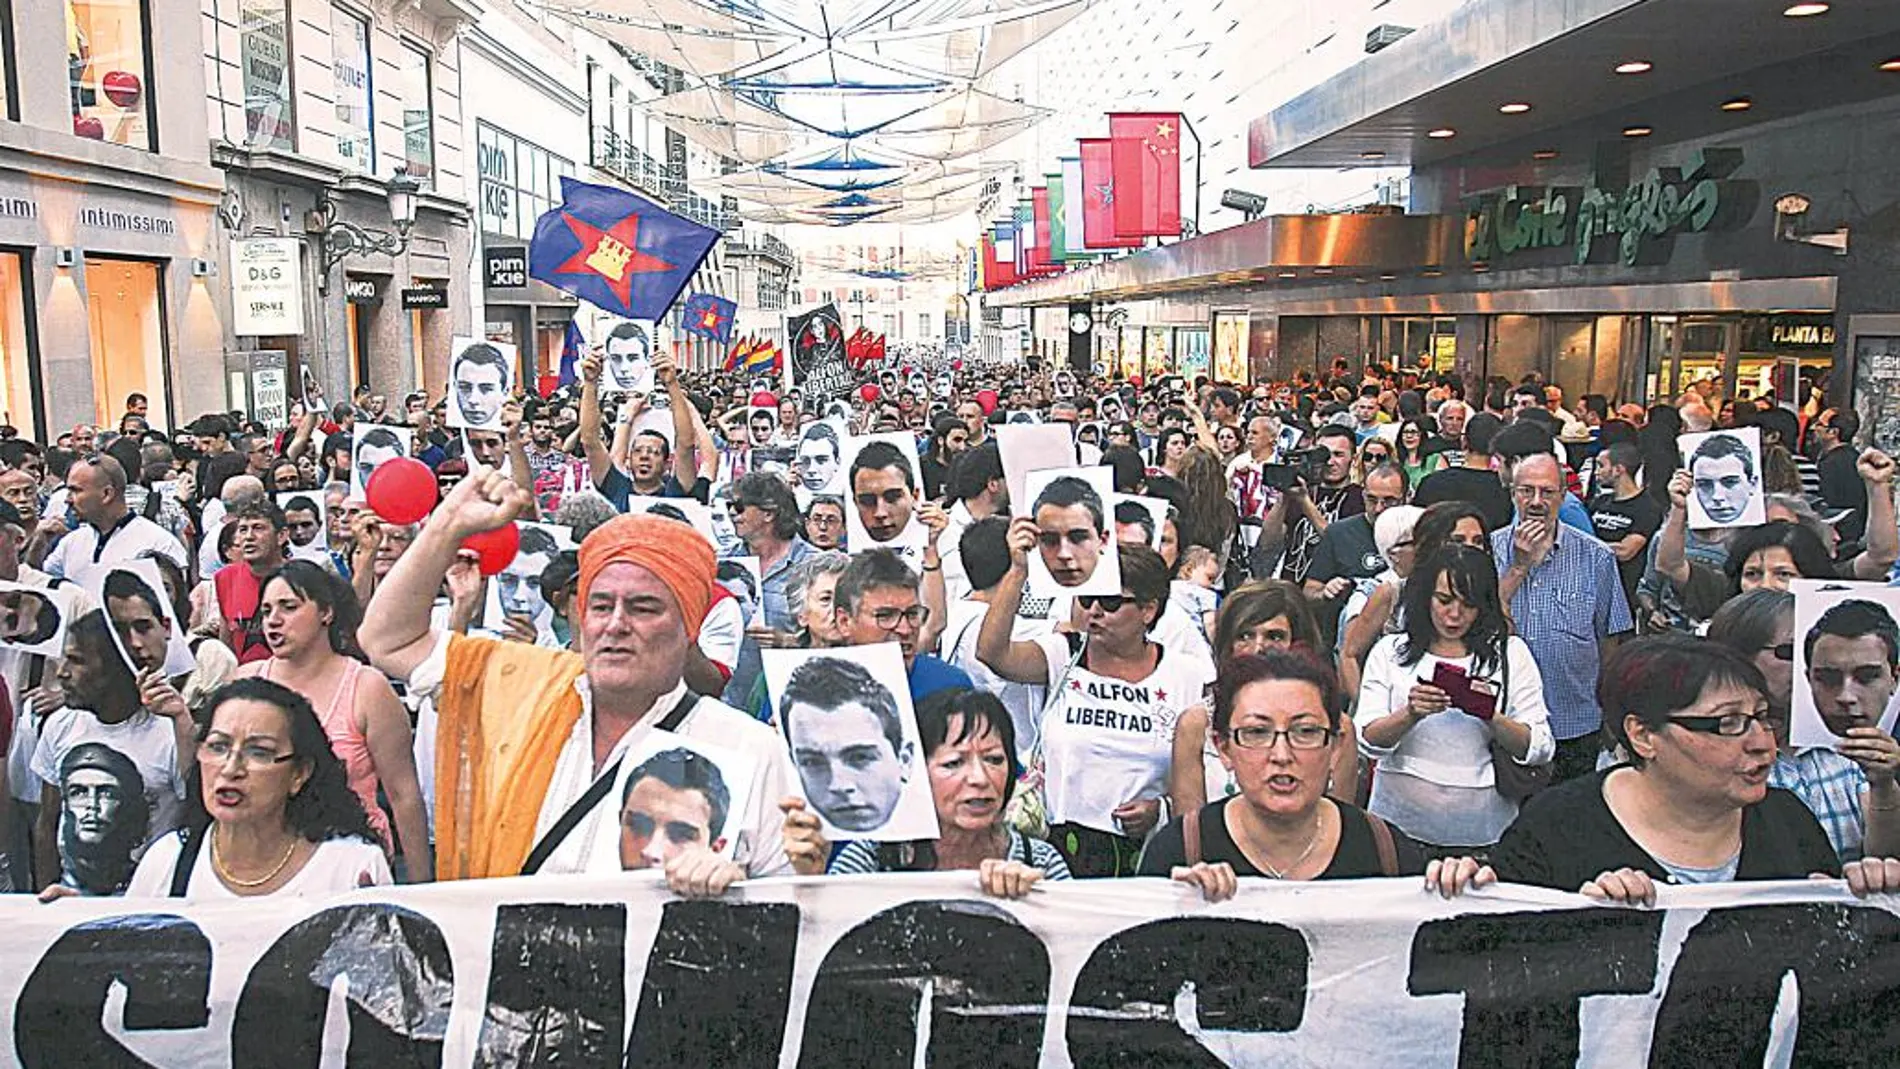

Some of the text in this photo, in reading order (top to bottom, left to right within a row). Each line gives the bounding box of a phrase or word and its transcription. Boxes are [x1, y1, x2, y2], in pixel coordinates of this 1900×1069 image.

[248, 34, 281, 61] GUESS
[480, 143, 507, 181] pim
[0, 199, 37, 219] imi
[486, 184, 508, 220] kie
[80, 207, 174, 234] intimissimi
[1496, 184, 1567, 254] Corte
[248, 266, 282, 281] D&G
[489, 259, 524, 275] pim
[1772, 325, 1819, 343] PLANTA
[807, 360, 845, 381] ALFON
[1087, 682, 1150, 704] ALFON
[1066, 707, 1153, 733] LIBERTAD
